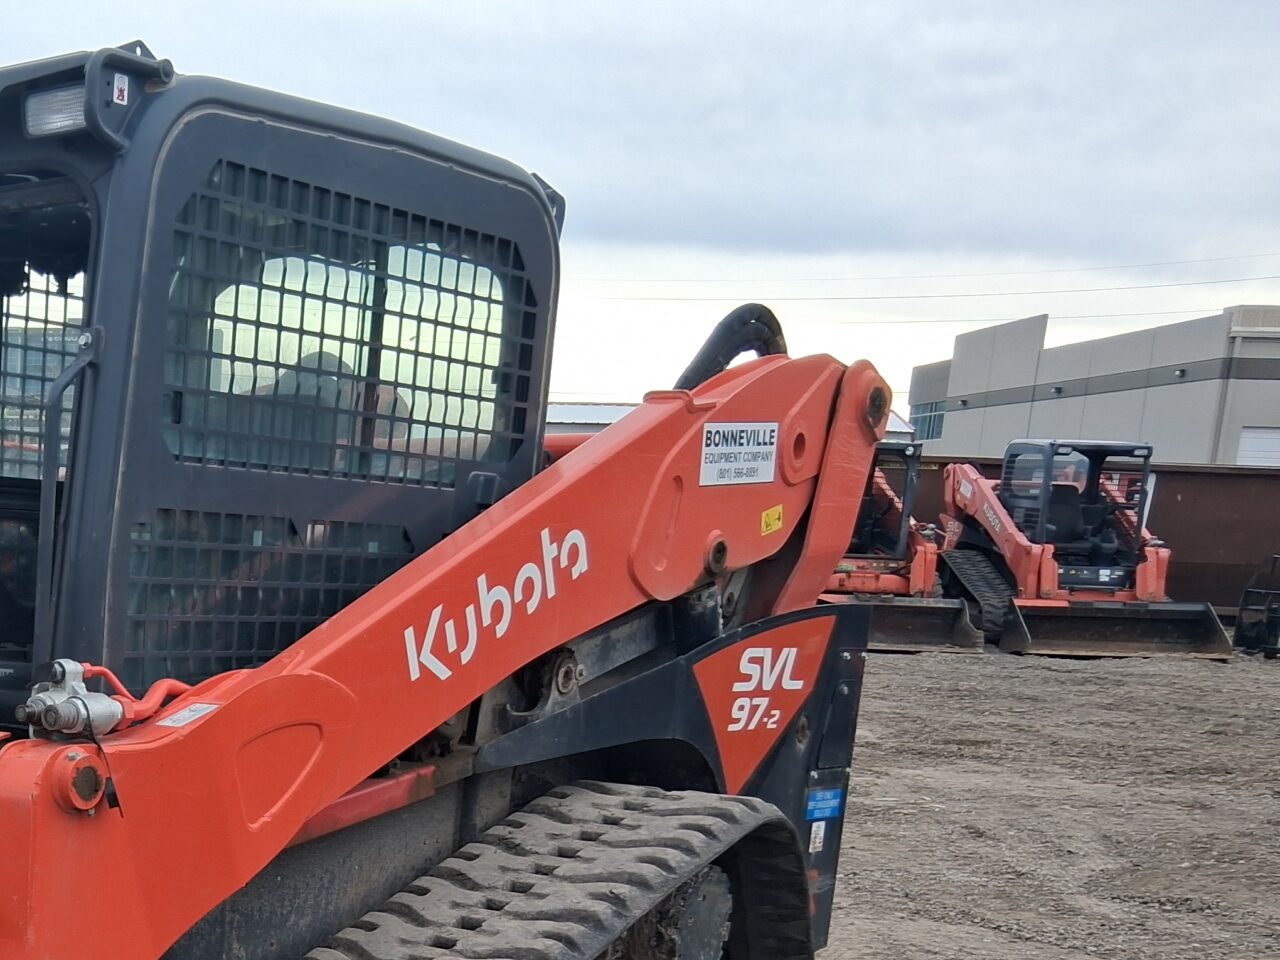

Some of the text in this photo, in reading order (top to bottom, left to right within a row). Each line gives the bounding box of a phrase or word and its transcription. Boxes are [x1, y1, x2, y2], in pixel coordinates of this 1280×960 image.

[705, 429, 776, 448] BONNEVILLE
[704, 450, 773, 464] EQUIPMENT COMPANY
[716, 468, 732, 481] (801)
[403, 527, 589, 682] Kubota
[732, 647, 804, 692] SVL
[727, 697, 781, 732] 97-2
